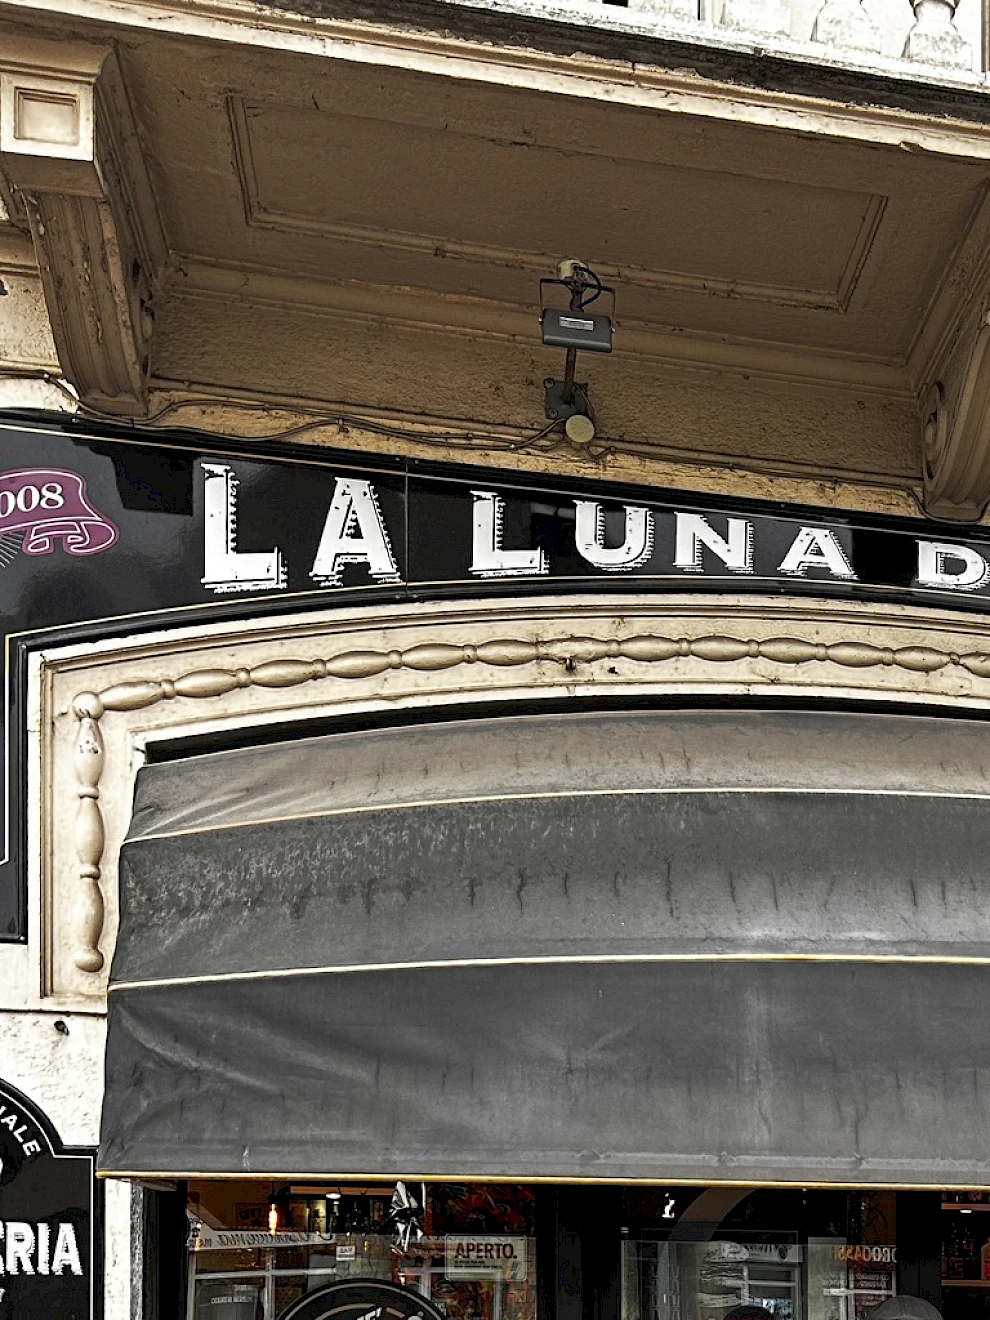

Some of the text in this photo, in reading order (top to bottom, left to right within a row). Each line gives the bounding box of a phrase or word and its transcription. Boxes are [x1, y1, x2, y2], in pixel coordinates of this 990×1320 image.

[201, 462, 403, 591] LA
[470, 490, 859, 581] LUNA
[0, 1106, 41, 1157] ALE
[0, 1221, 83, 1276] RIA
